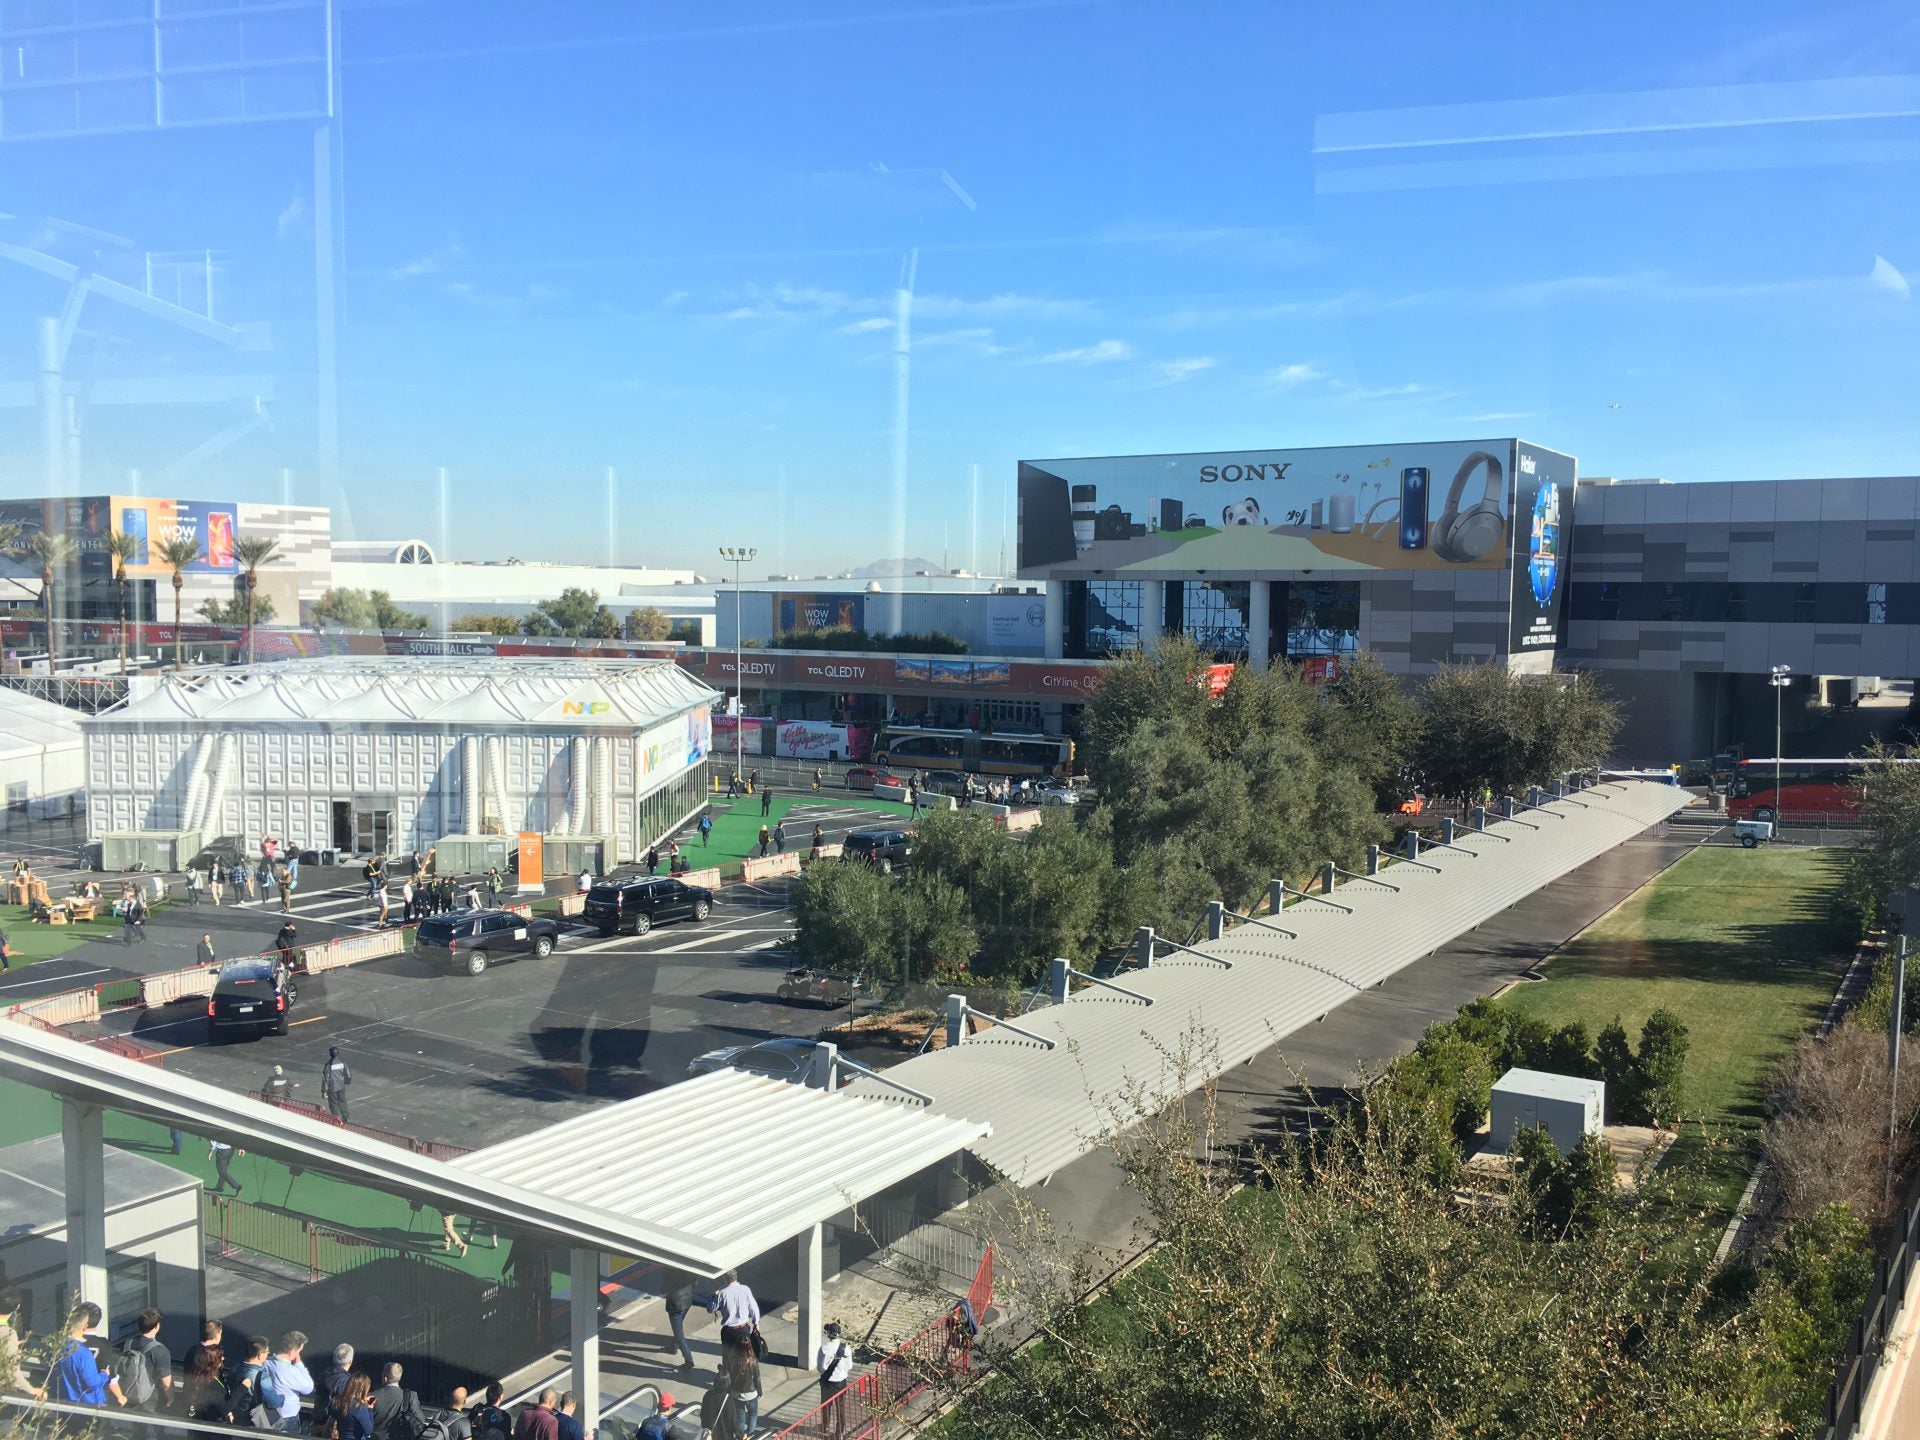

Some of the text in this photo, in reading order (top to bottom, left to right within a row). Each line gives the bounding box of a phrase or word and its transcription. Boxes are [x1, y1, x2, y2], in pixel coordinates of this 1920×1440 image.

[1520, 454, 1536, 475] Haier
[1199, 463, 1292, 483] SONY
[158, 525, 197, 537] WOW
[804, 609, 829, 618] WOW
[806, 617, 827, 627] WAY
[159, 631, 173, 639] TCL
[409, 642, 440, 654] SOUTH
[443, 643, 472, 655] HALLS
[721, 663, 737, 671] TCL
[807, 667, 823, 675] TCL
[1043, 675, 1078, 688] Cityline
[562, 700, 610, 715] NXP
[783, 725, 808, 742] Hello
[643, 744, 660, 776] NXP
